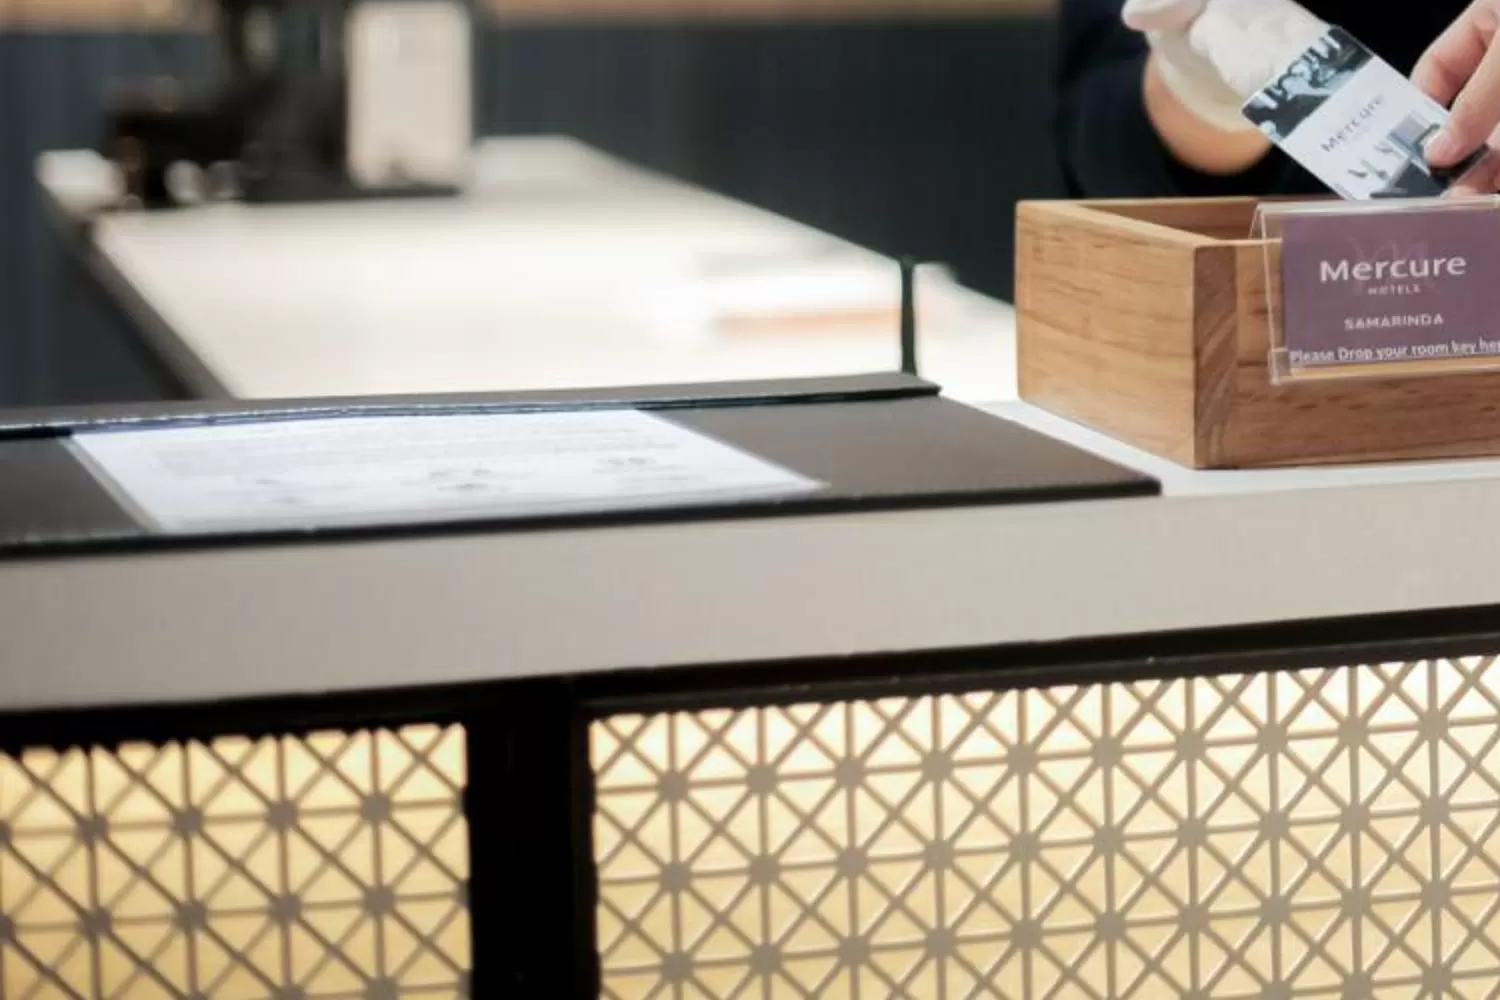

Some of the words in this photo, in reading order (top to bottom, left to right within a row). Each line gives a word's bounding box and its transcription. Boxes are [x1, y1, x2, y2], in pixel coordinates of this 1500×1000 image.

[1319, 255, 1467, 283] Mercure
[1367, 284, 1421, 296] HOTELS
[1343, 312, 1445, 331] SAMARINDA
[1290, 346, 1335, 362] Please
[1338, 346, 1373, 361] Drop
[1376, 347, 1408, 361] your
[1410, 344, 1449, 357] room
[1450, 341, 1477, 355] key
